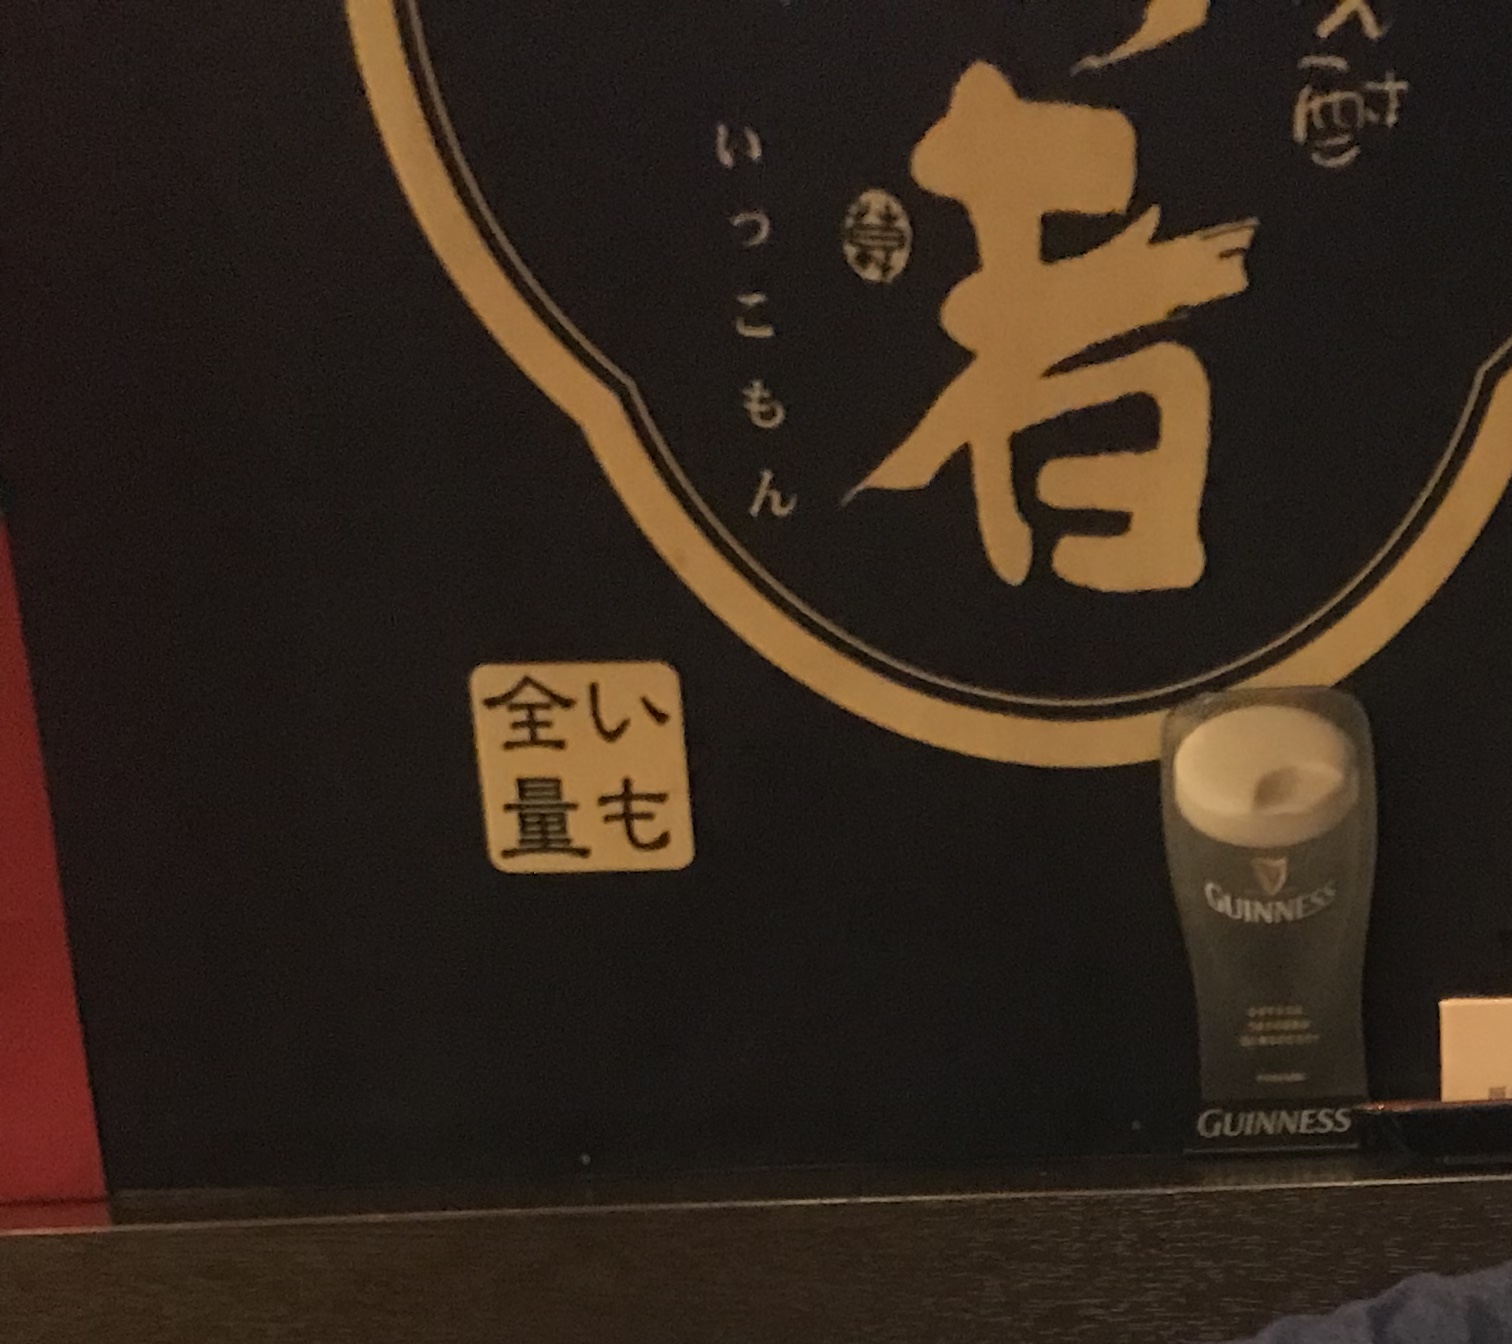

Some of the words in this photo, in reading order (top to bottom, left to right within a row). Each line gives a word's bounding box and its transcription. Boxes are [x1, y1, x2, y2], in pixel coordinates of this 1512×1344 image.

[838, 0, 1260, 592] 者
[1204, 881, 1337, 924] GUINNESS
[1197, 1107, 1352, 1138] GUINNESS
